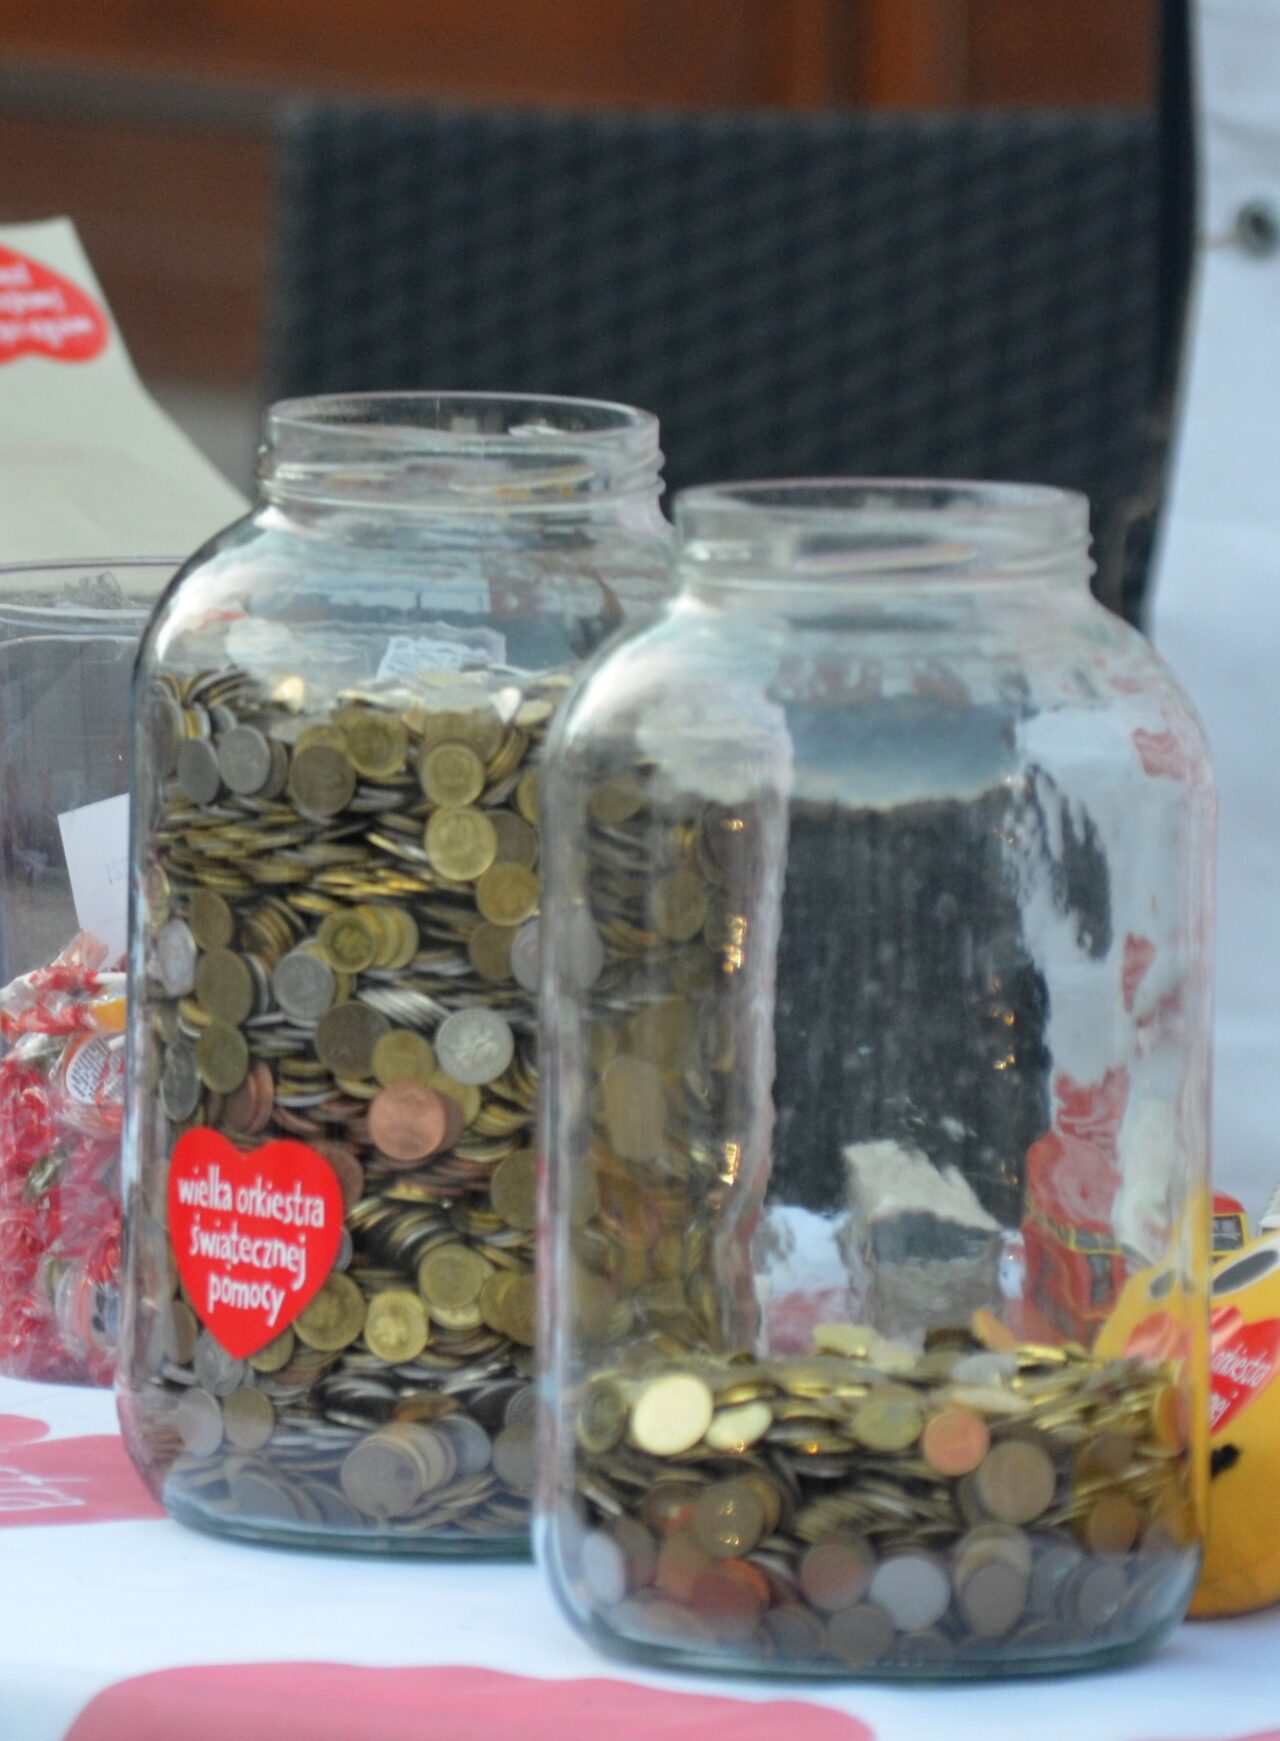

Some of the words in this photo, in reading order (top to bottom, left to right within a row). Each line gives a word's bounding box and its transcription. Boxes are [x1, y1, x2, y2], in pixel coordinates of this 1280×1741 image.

[178, 1163, 232, 1212] wielka
[236, 1175, 325, 1229] orkiestra
[190, 1213, 306, 1291] świątecznej
[208, 1272, 285, 1327] pomocy
